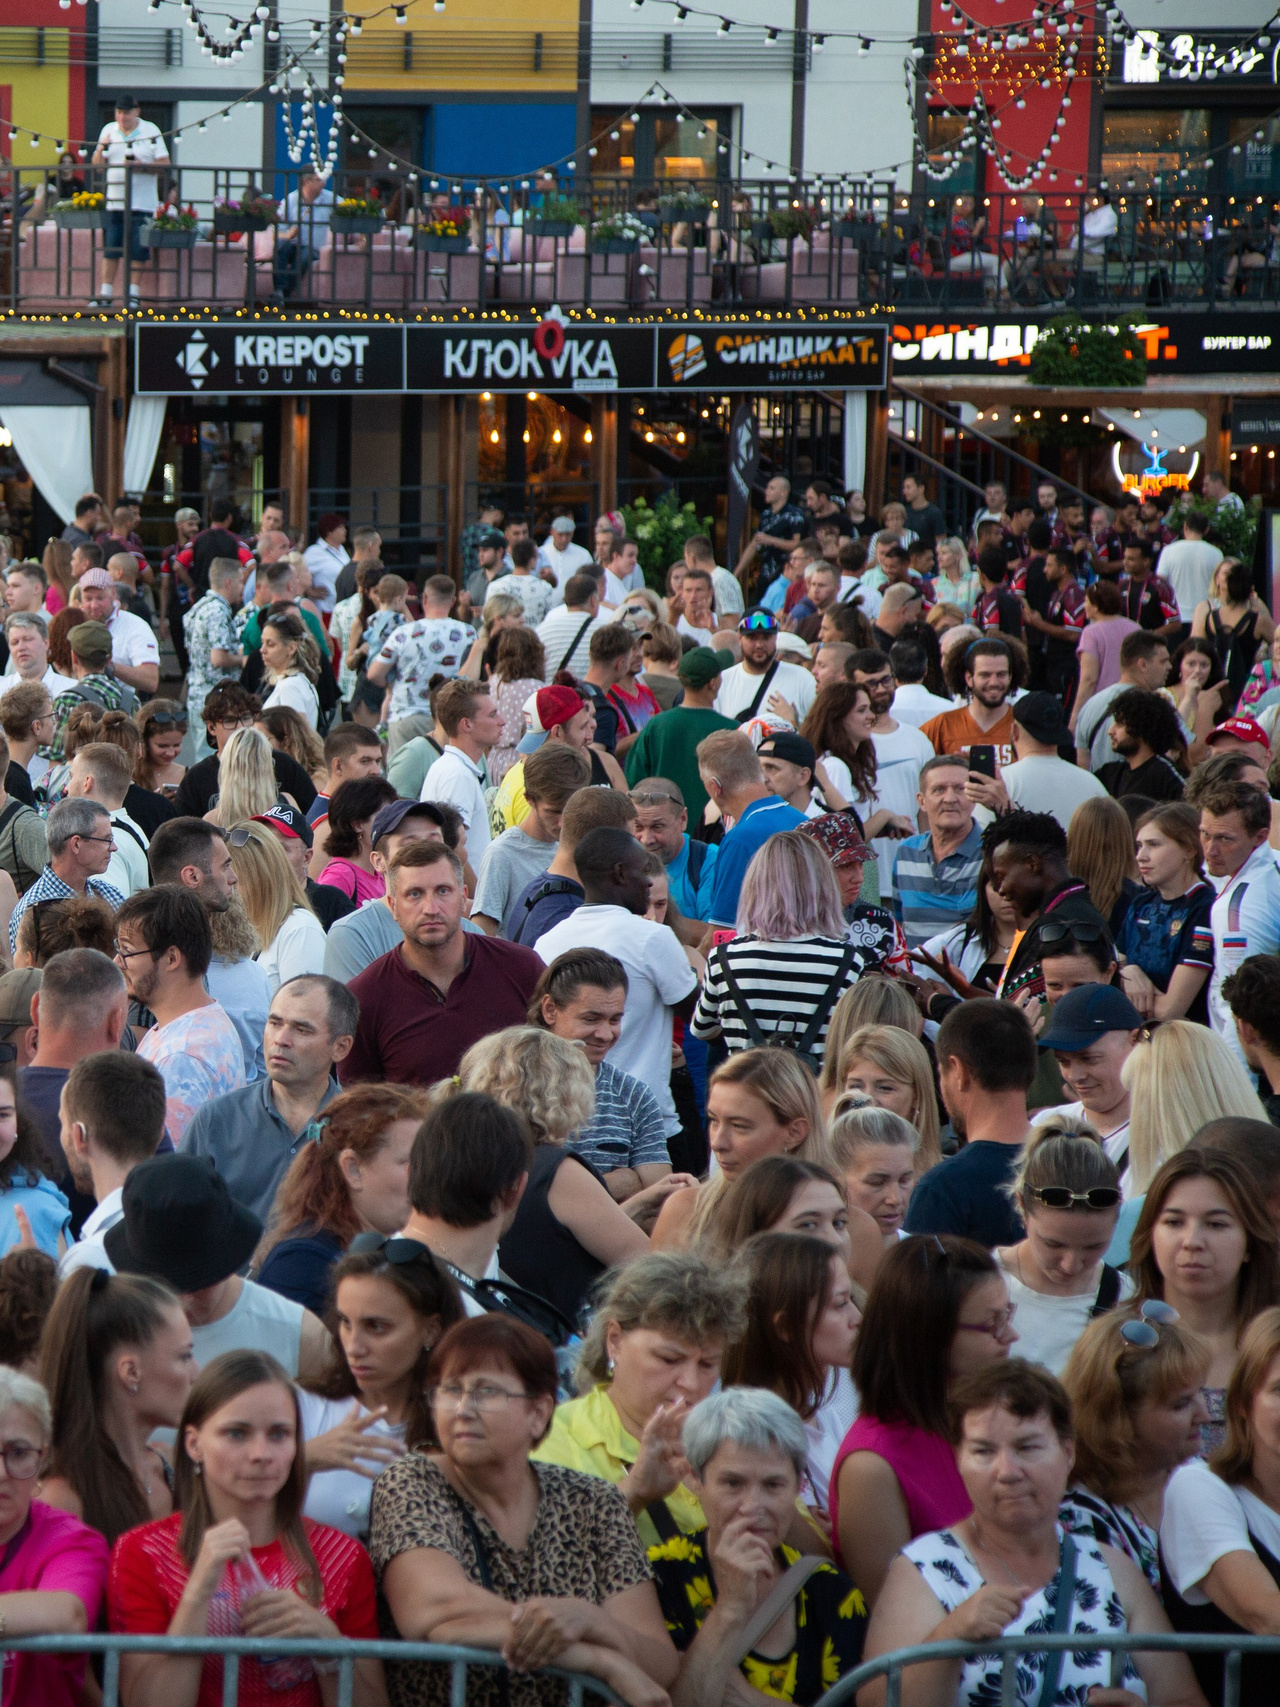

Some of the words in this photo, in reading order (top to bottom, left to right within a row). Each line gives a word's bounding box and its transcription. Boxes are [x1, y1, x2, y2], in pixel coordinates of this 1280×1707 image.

[234, 335, 370, 367] KREPOST
[1202, 336, 1247, 351] БУРГЕР
[1248, 336, 1272, 350] БАР
[235, 368, 365, 384] LOUNGE
[768, 370, 804, 381] БУРГЕР
[807, 370, 825, 381] БАР
[1123, 472, 1191, 493] BURGER
